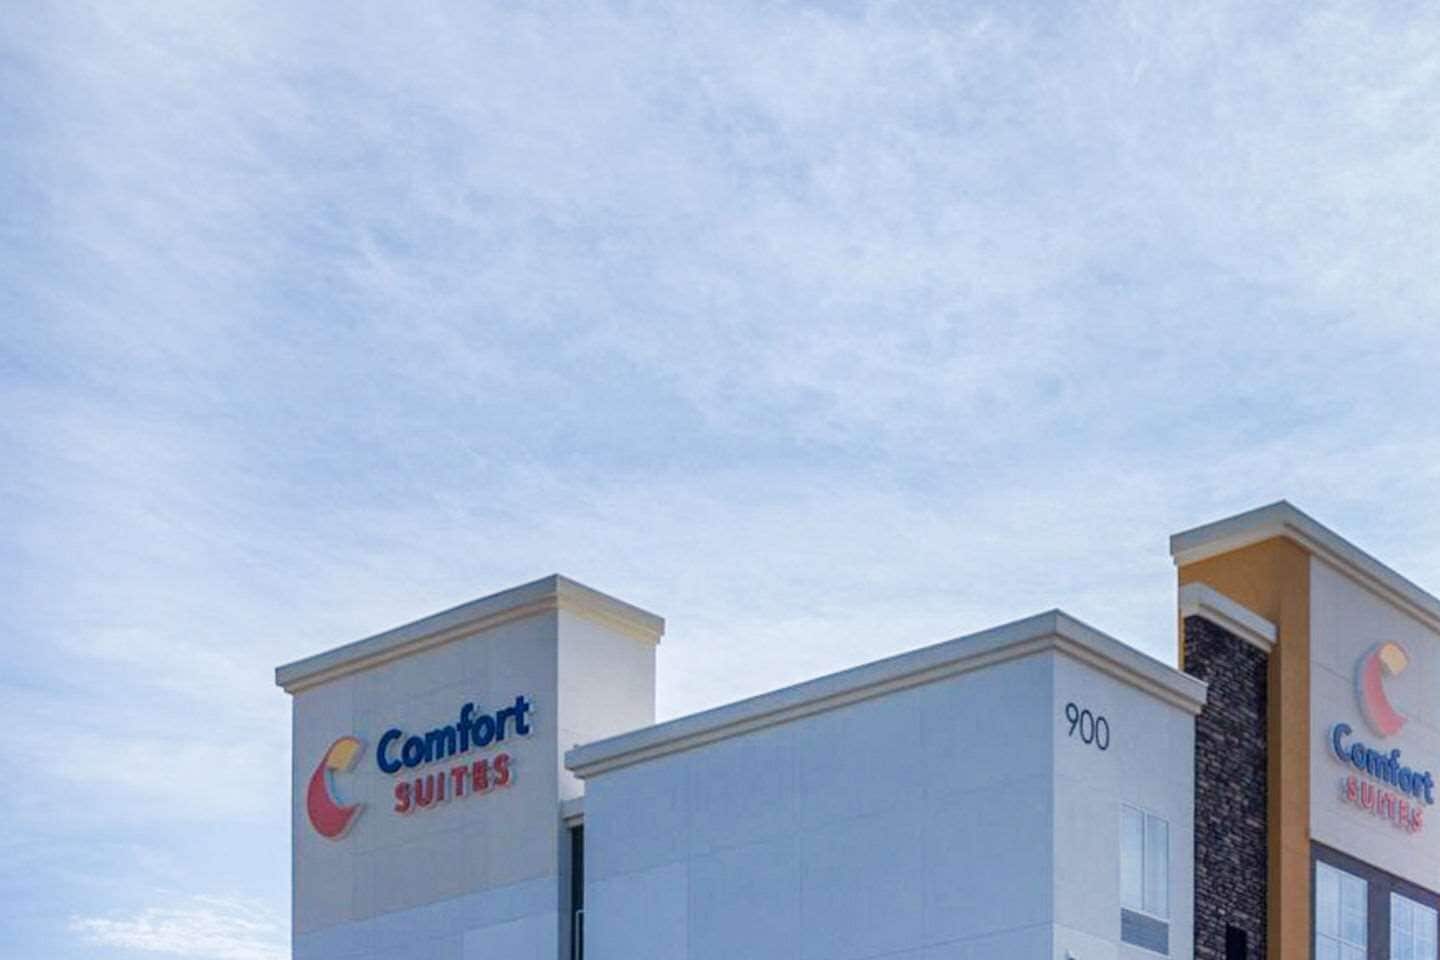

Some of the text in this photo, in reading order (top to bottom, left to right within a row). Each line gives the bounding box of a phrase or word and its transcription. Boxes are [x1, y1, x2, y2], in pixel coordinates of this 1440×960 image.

[376, 695, 530, 774] Comfort
[1065, 702, 1110, 751] 900
[393, 752, 512, 813] SUITES
[1331, 722, 1436, 805] Comfort
[1345, 775, 1425, 833] SUITES
